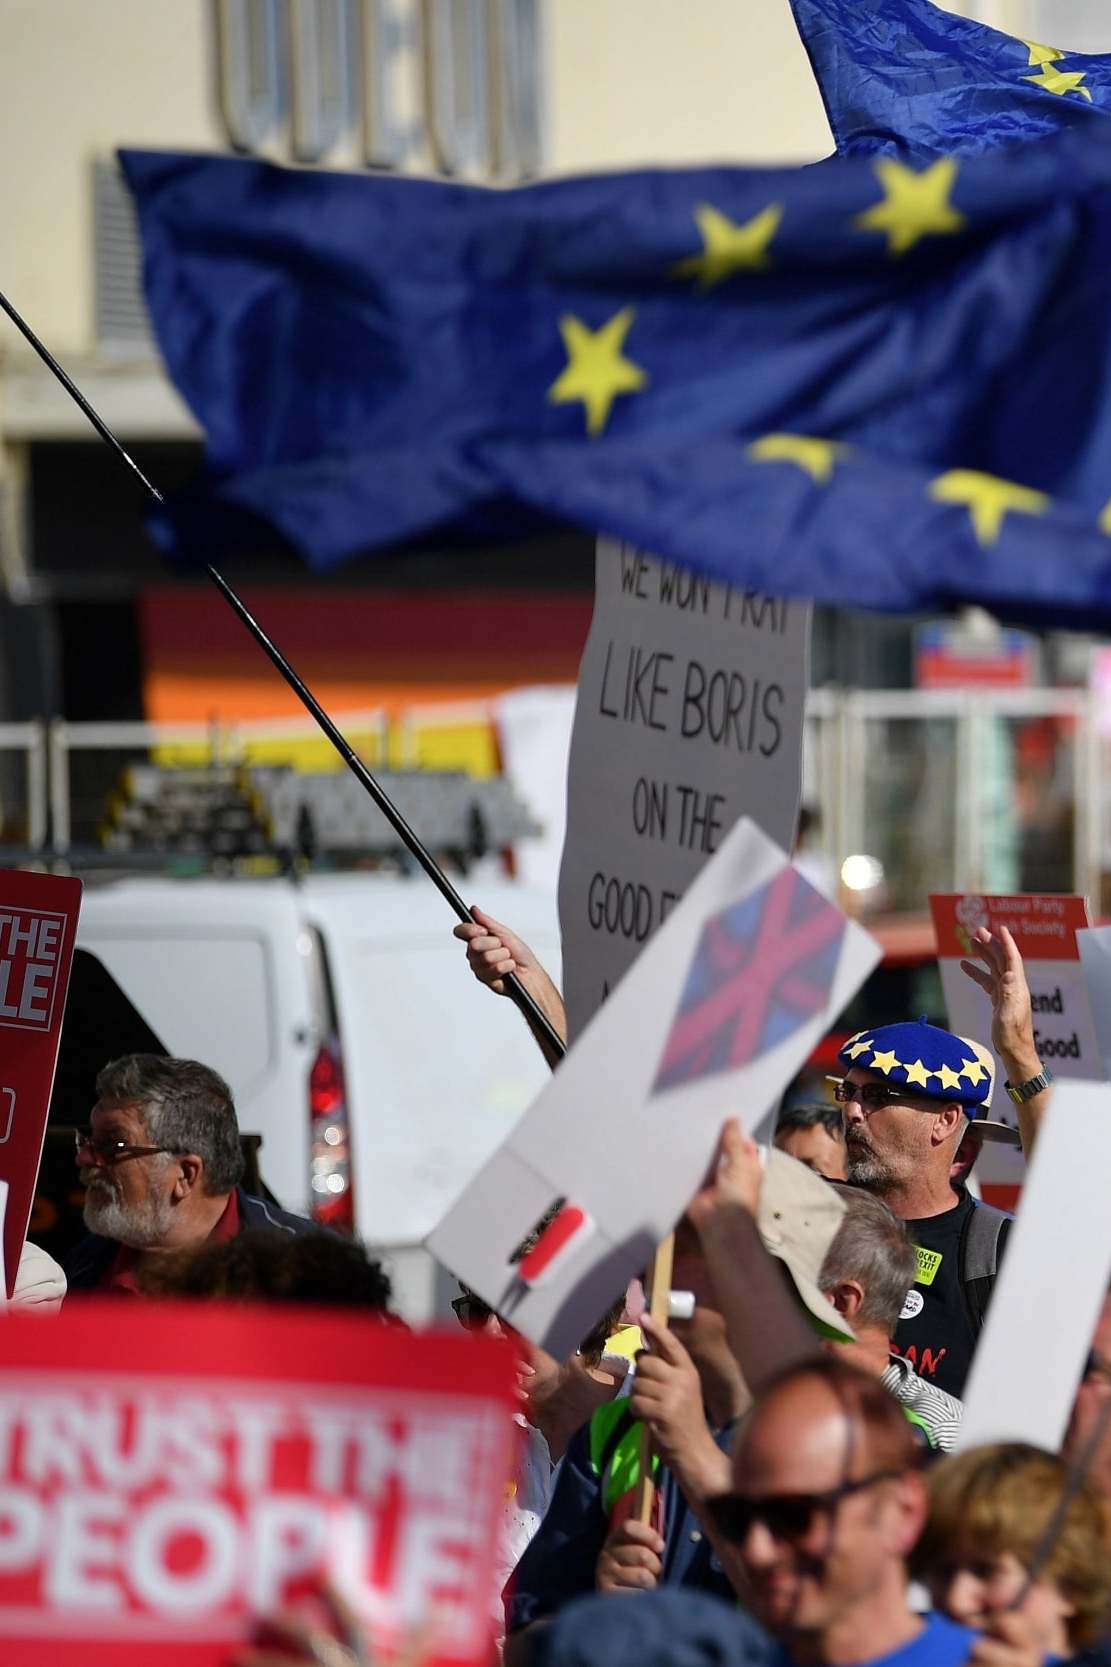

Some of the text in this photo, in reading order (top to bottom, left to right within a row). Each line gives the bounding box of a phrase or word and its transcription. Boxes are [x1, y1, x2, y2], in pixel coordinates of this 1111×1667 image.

[621, 543, 648, 598] WE
[600, 639, 786, 758] LIKE BORIS
[632, 777, 727, 855] ON THE
[588, 871, 652, 942] GOOD
